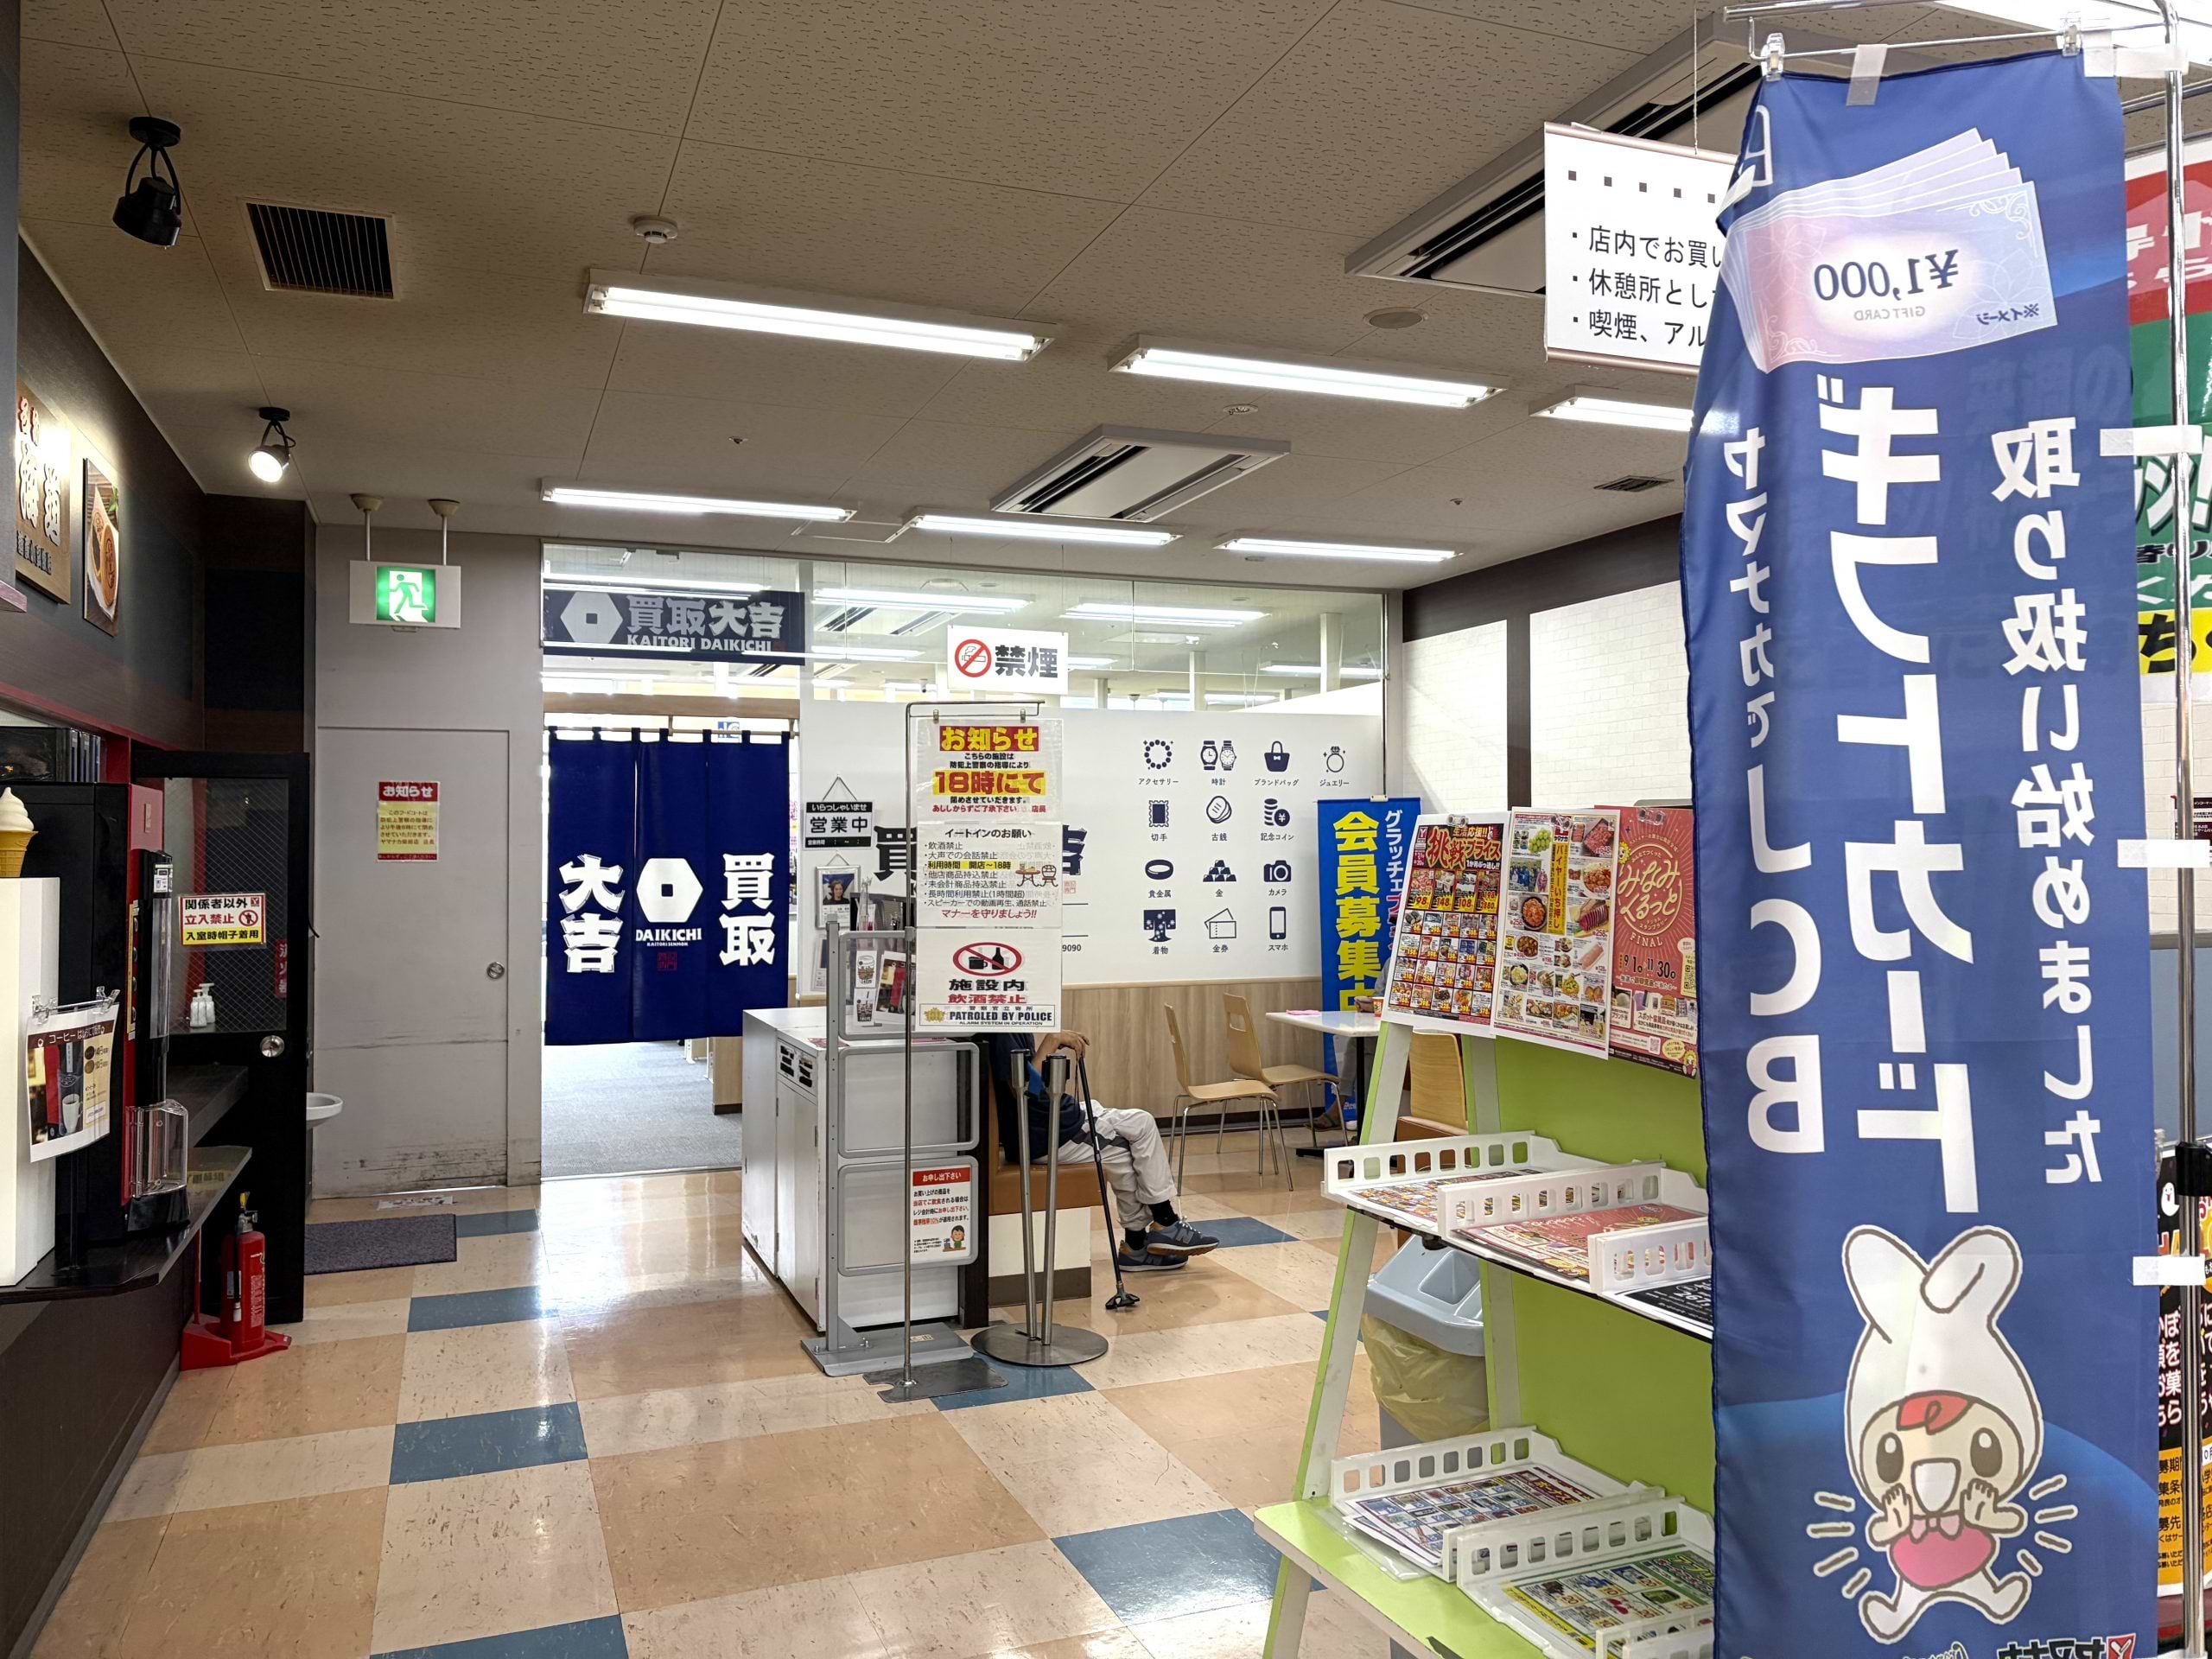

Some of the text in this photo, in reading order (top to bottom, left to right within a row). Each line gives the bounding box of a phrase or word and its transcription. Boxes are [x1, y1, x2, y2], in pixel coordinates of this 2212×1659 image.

[626, 595, 785, 639] 買取大吉
[626, 633, 772, 652] KAITORI DAIKICHI
[995, 645, 1058, 678] 禁煙
[941, 727, 1037, 751] お知らせ
[935, 771, 1045, 795] 18時にて
[383, 785, 433, 798] お知らせ
[810, 816, 868, 833] 営業中
[944, 829, 1032, 839] イートインのお願い
[1151, 833, 1167, 842] 切手
[1211, 833, 1228, 842] 古銭
[1261, 833, 1294, 842] 記念コイン
[1148, 889, 1172, 898] 貴金属
[1215, 889, 1224, 898] 金
[185, 898, 248, 910] 関係者以外
[719, 853, 775, 966] 買取
[184, 913, 235, 925] 立入禁止
[558, 854, 626, 973] 大吉
[186, 930, 259, 941] 入室時帽子着用
[636, 928, 702, 941] DAIKICHI
[1630, 932, 1663, 948] FINAL
[1153, 946, 1168, 955] 着物
[1212, 944, 1229, 953] 金券
[949, 979, 1025, 991] 施設内
[948, 995, 1027, 1004] 飲酒禁止
[950, 1011, 1052, 1021] PATROLED BY POLICE
[922, 1172, 961, 1182] お申し出下さい
